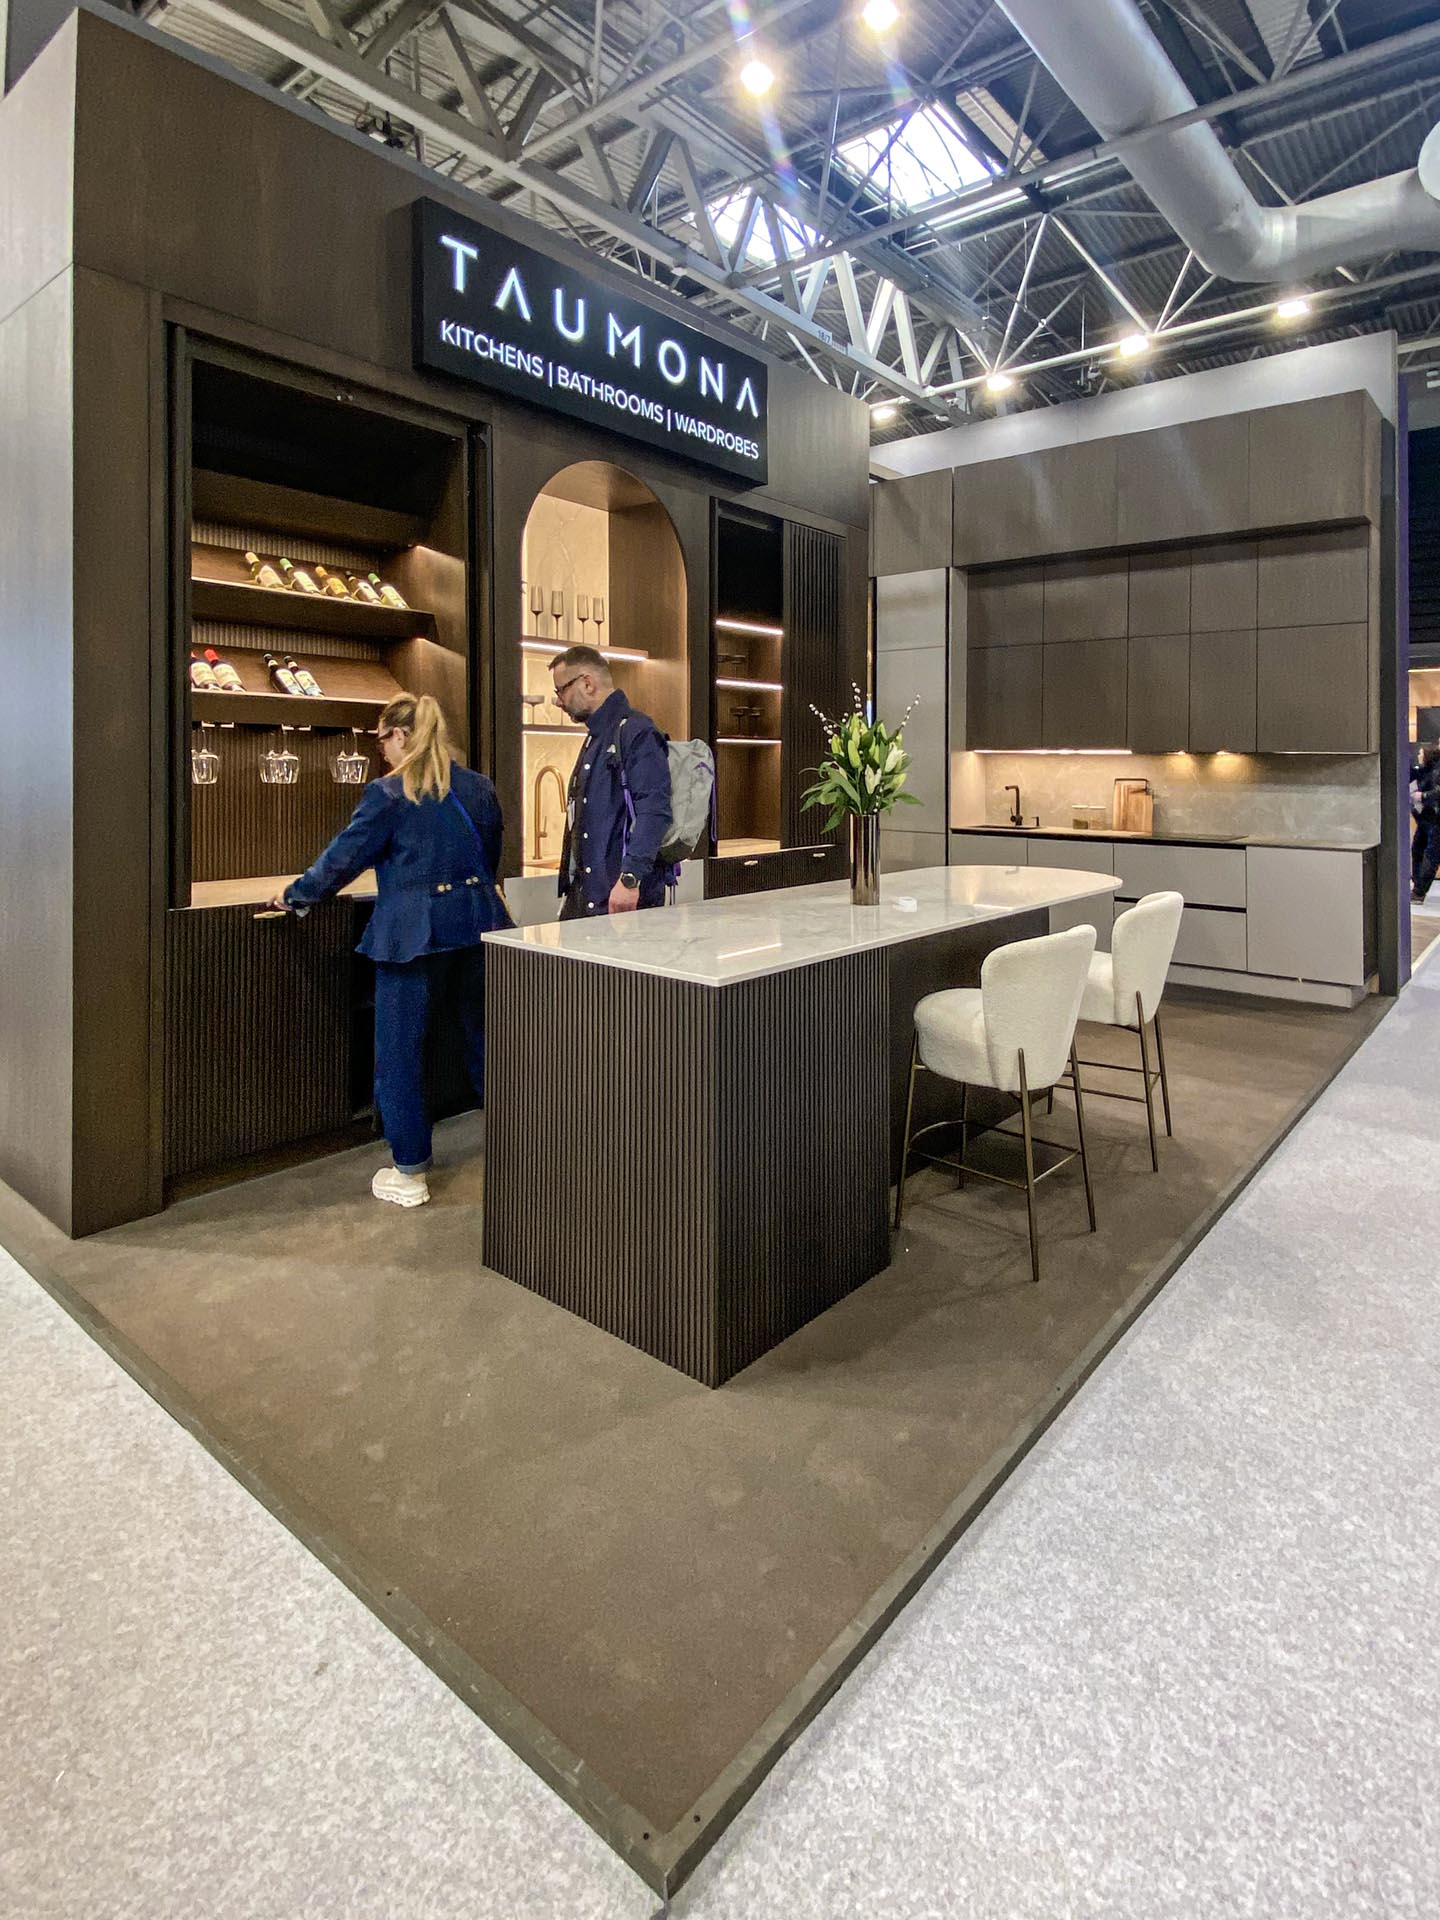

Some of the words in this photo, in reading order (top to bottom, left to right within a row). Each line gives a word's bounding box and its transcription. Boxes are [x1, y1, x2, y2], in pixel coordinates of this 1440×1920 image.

[441, 320, 544, 378] KITCHENS
[557, 365, 664, 424] BATHROOMS
[674, 411, 760, 460] WARDROBES
